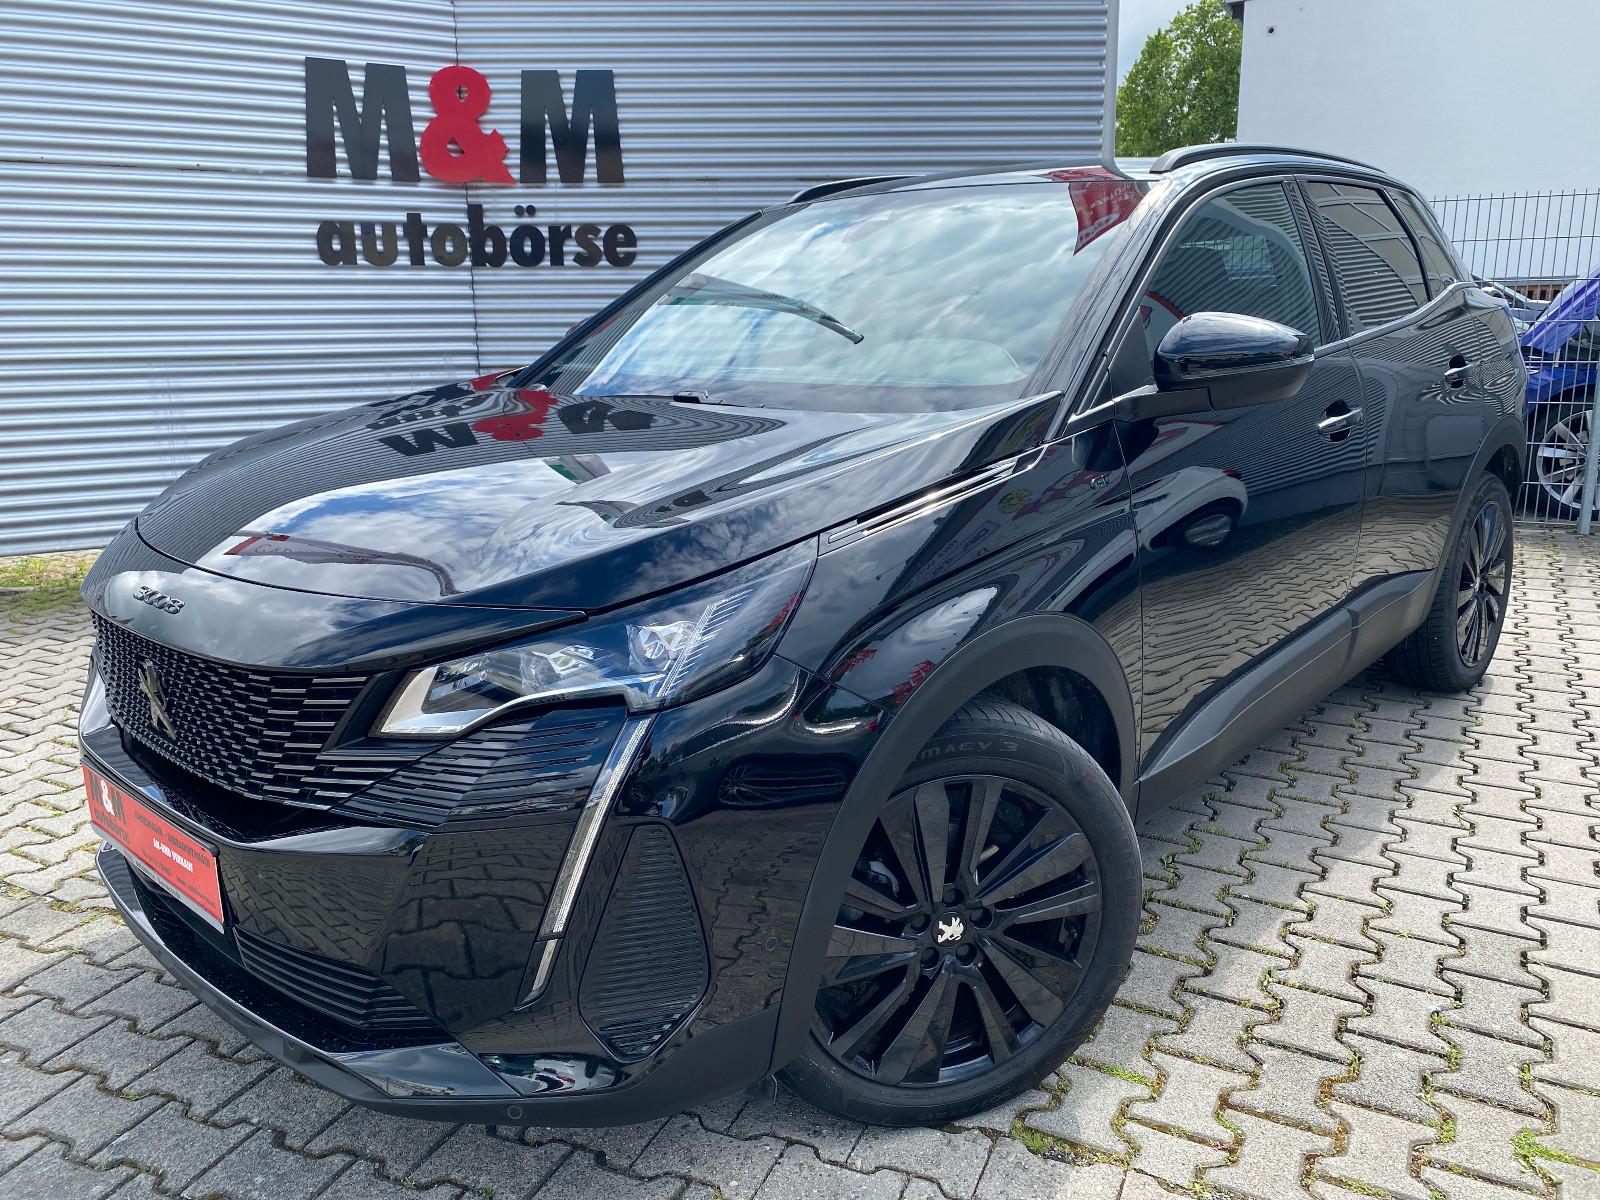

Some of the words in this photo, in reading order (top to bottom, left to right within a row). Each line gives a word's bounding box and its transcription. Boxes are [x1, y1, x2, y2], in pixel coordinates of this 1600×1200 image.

[305, 57, 625, 184] M&M
[316, 204, 638, 267] autobörse
[133, 585, 185, 615] 3008
